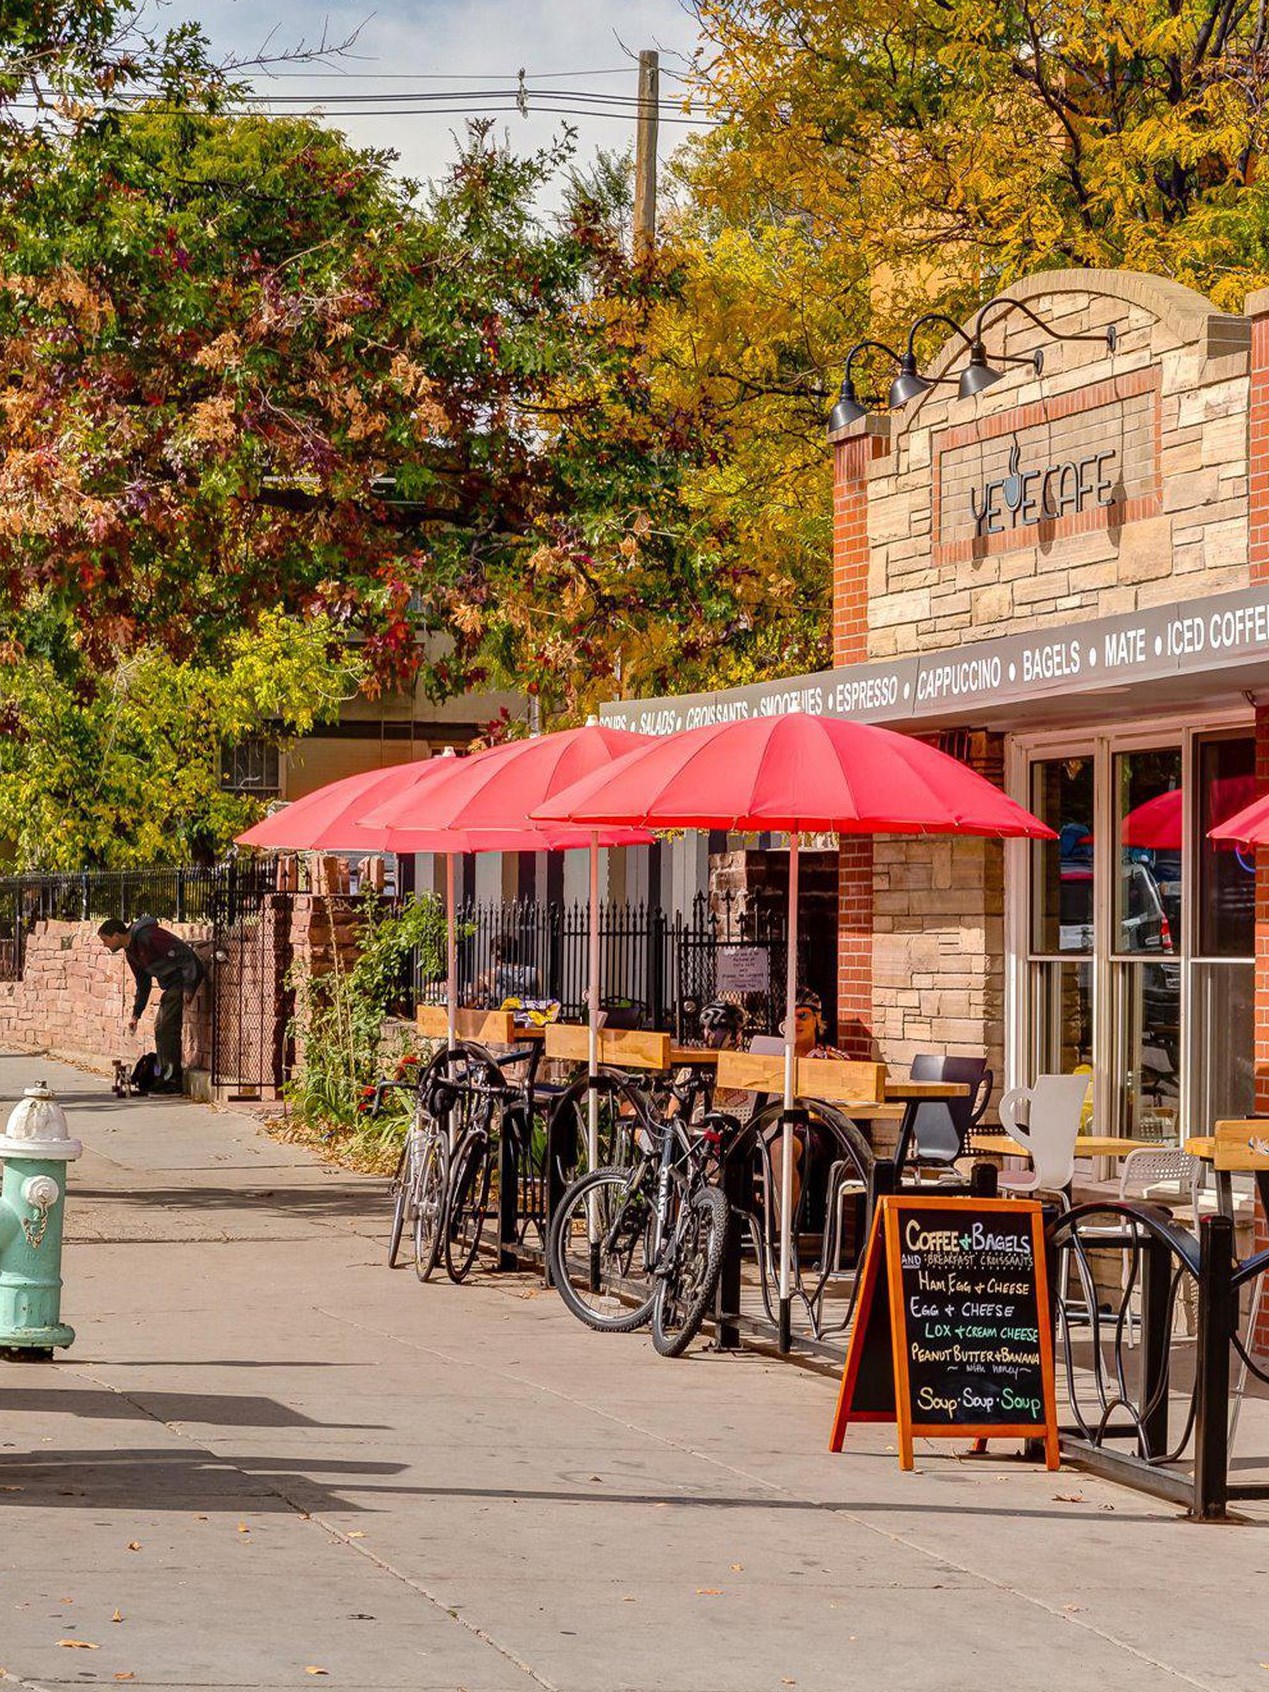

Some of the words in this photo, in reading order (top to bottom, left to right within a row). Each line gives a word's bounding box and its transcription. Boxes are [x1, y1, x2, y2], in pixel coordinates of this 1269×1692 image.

[640, 710, 676, 735] SALADS
[686, 701, 749, 732] CROISSANTS
[836, 676, 898, 712] ESPRESSO
[917, 656, 1001, 700] CAPPUCCINO
[1023, 640, 1080, 681] BAGELS
[1104, 629, 1146, 667] MATE
[1167, 617, 1205, 656] ICED
[906, 1219, 960, 1251] COFFEE
[972, 1222, 1031, 1254] BAGELS
[901, 1254, 921, 1266] AND
[928, 1253, 975, 1266] BREAKFAST
[987, 1278, 1030, 1295] CHEESE
[910, 1296, 939, 1318] EGG
[961, 1302, 1015, 1317] CHEESE
[925, 1322, 952, 1338] LOX
[1000, 1327, 1038, 1342] CHEESE
[911, 1342, 952, 1362] PEANUT
[953, 1344, 993, 1362] BUTTER
[1001, 1347, 1040, 1365] BANANA
